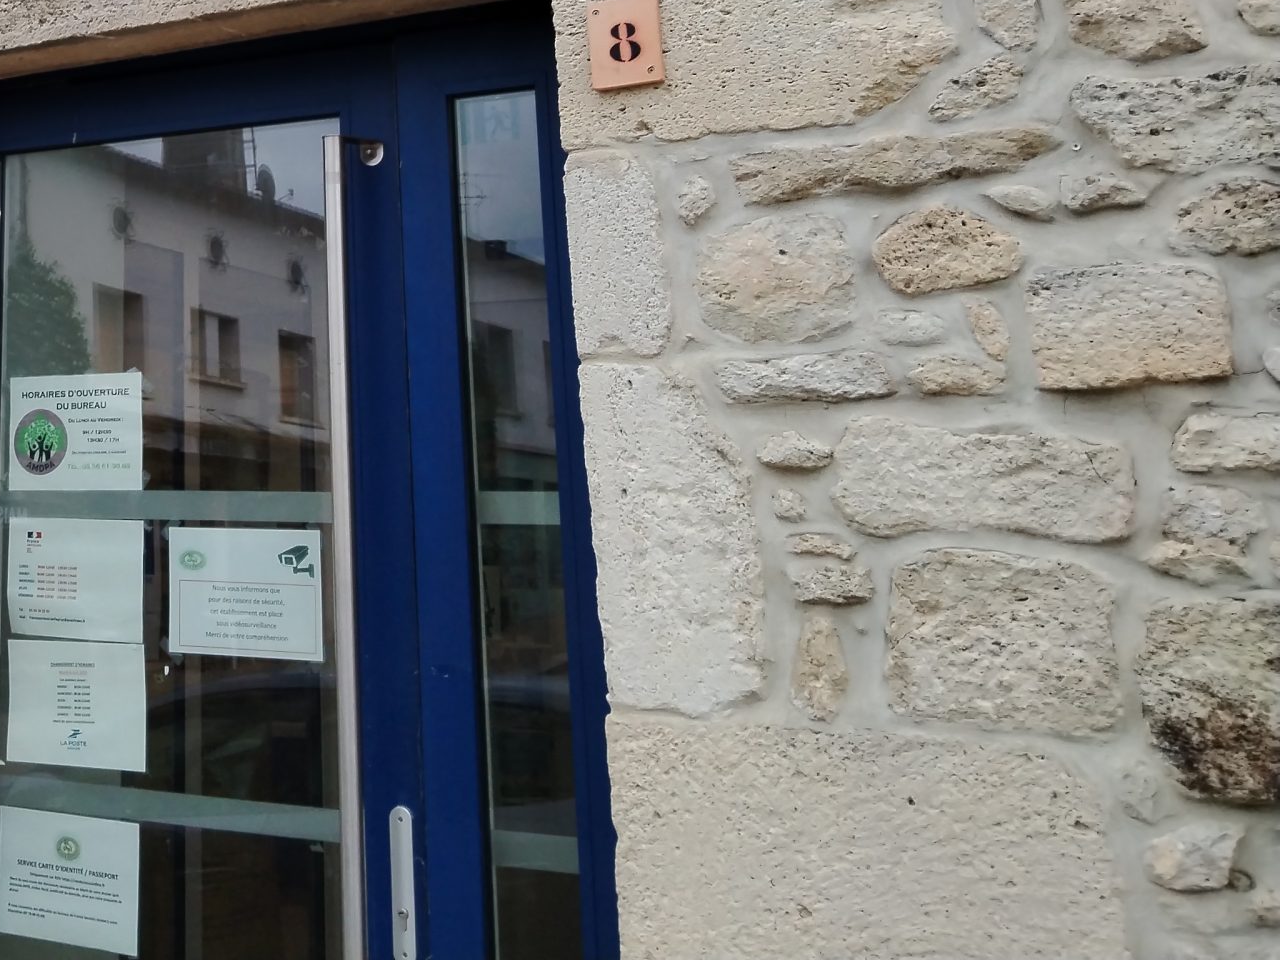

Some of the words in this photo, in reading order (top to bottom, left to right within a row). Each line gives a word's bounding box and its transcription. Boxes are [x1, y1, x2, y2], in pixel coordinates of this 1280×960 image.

[609, 22, 642, 63] 8
[21, 390, 66, 399] HORAIRES
[67, 387, 130, 398] D'OUVERTURE
[56, 402, 69, 410] DU
[71, 401, 107, 410] BUREAU
[17, 859, 37, 868] SERVICE
